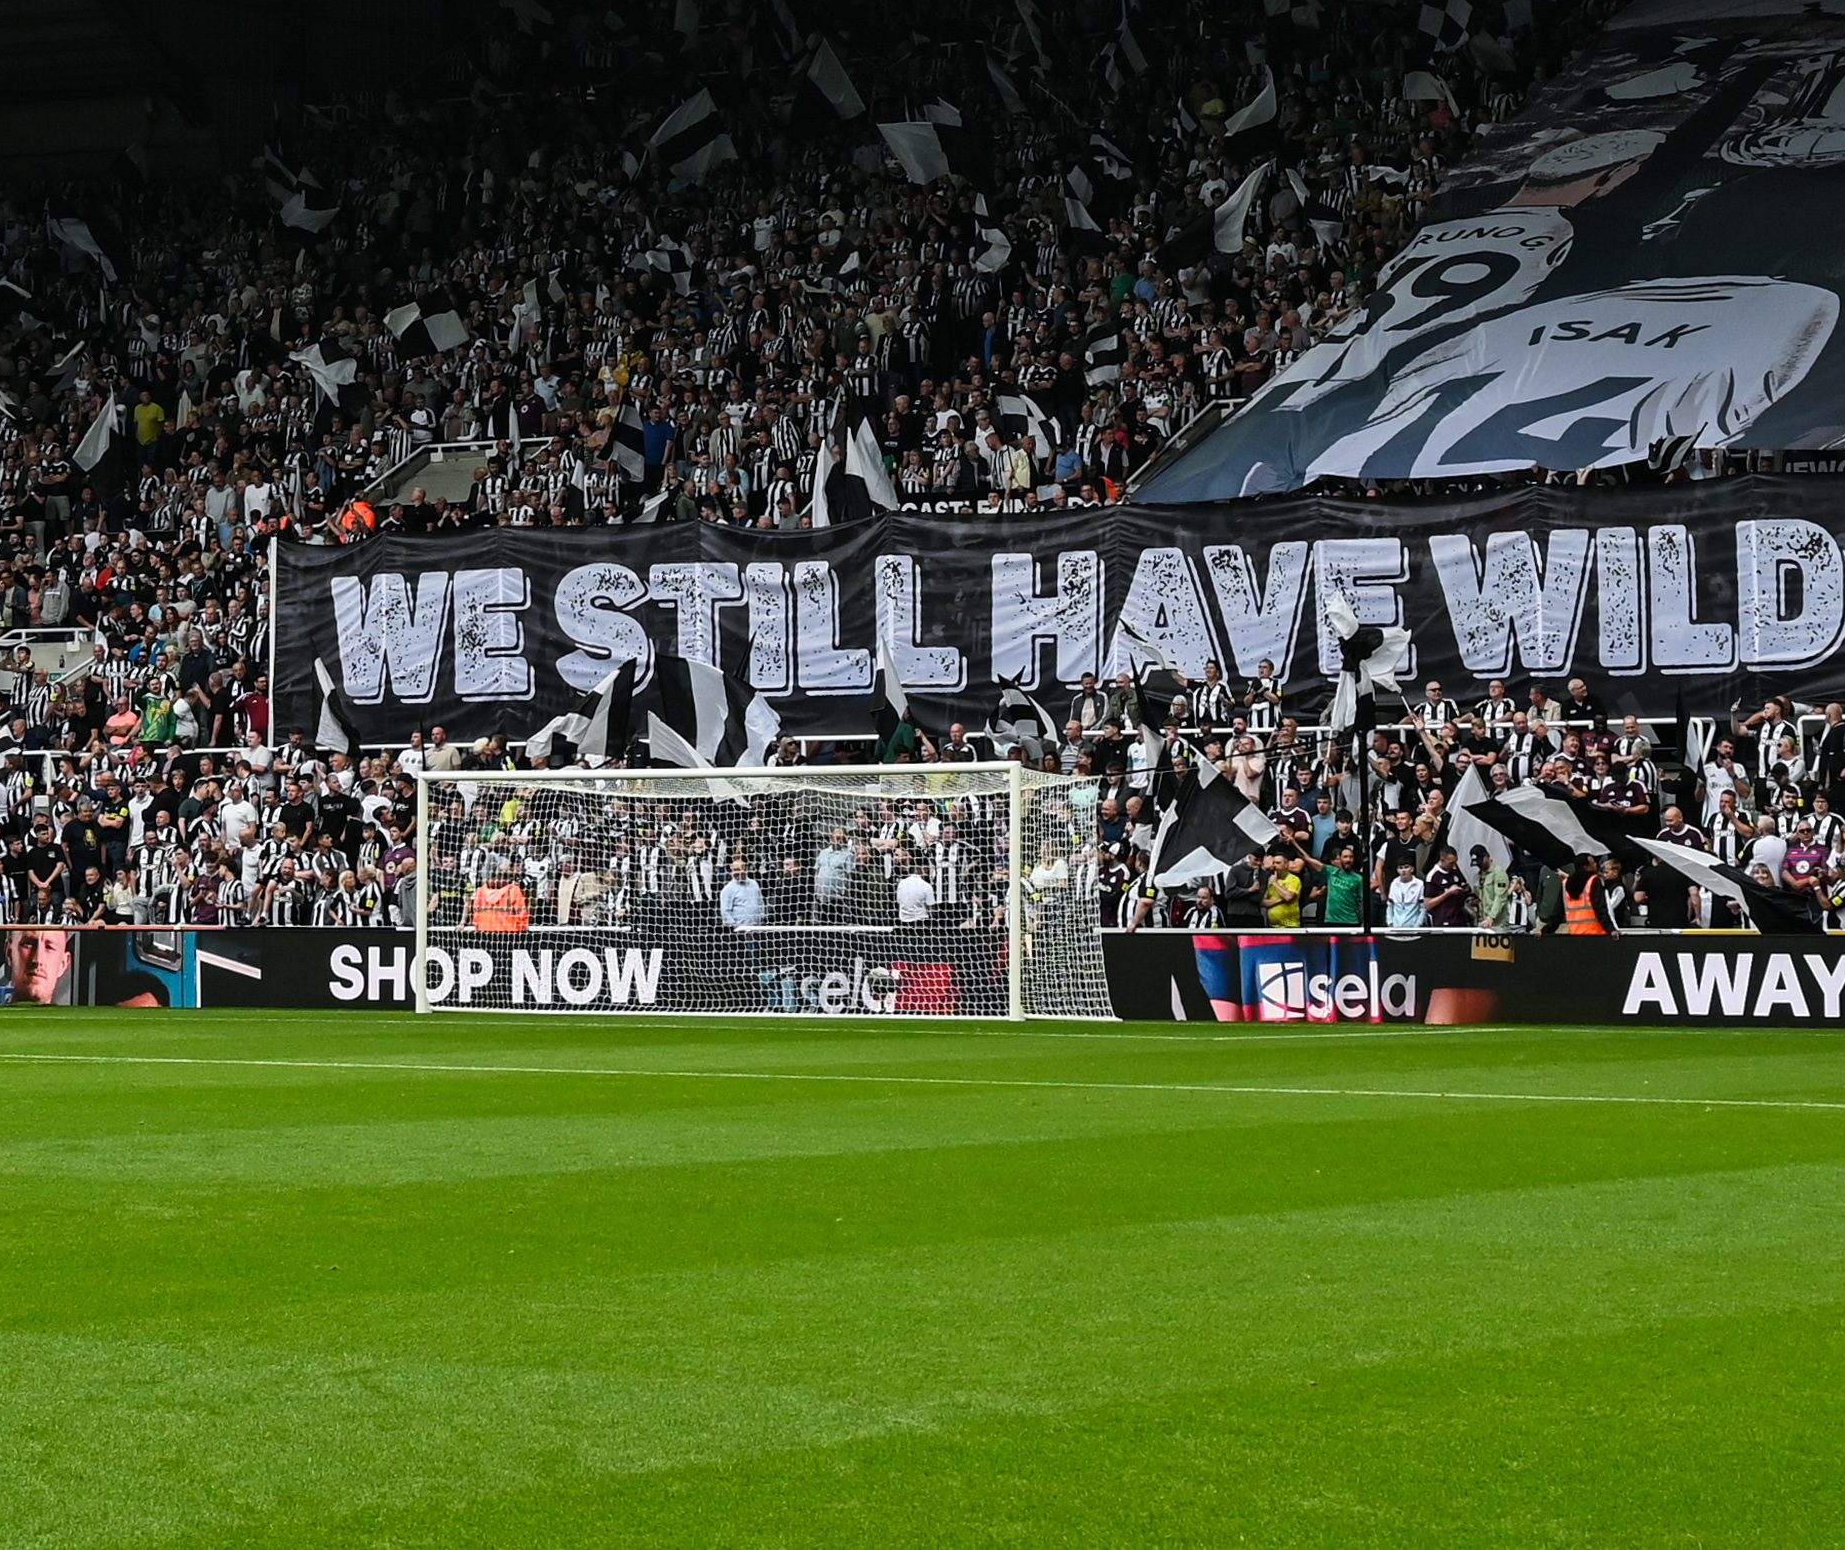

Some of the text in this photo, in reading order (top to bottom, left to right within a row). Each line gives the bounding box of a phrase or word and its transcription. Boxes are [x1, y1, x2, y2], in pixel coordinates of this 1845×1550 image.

[1410, 226, 1525, 248] RUNO
[1528, 320, 1713, 349] ISAK
[330, 567, 535, 704] WE
[555, 554, 968, 698] STILL
[991, 537, 1418, 692] HAVE
[329, 943, 663, 1005] SHOP NOW
[1308, 960, 1417, 1018] sela
